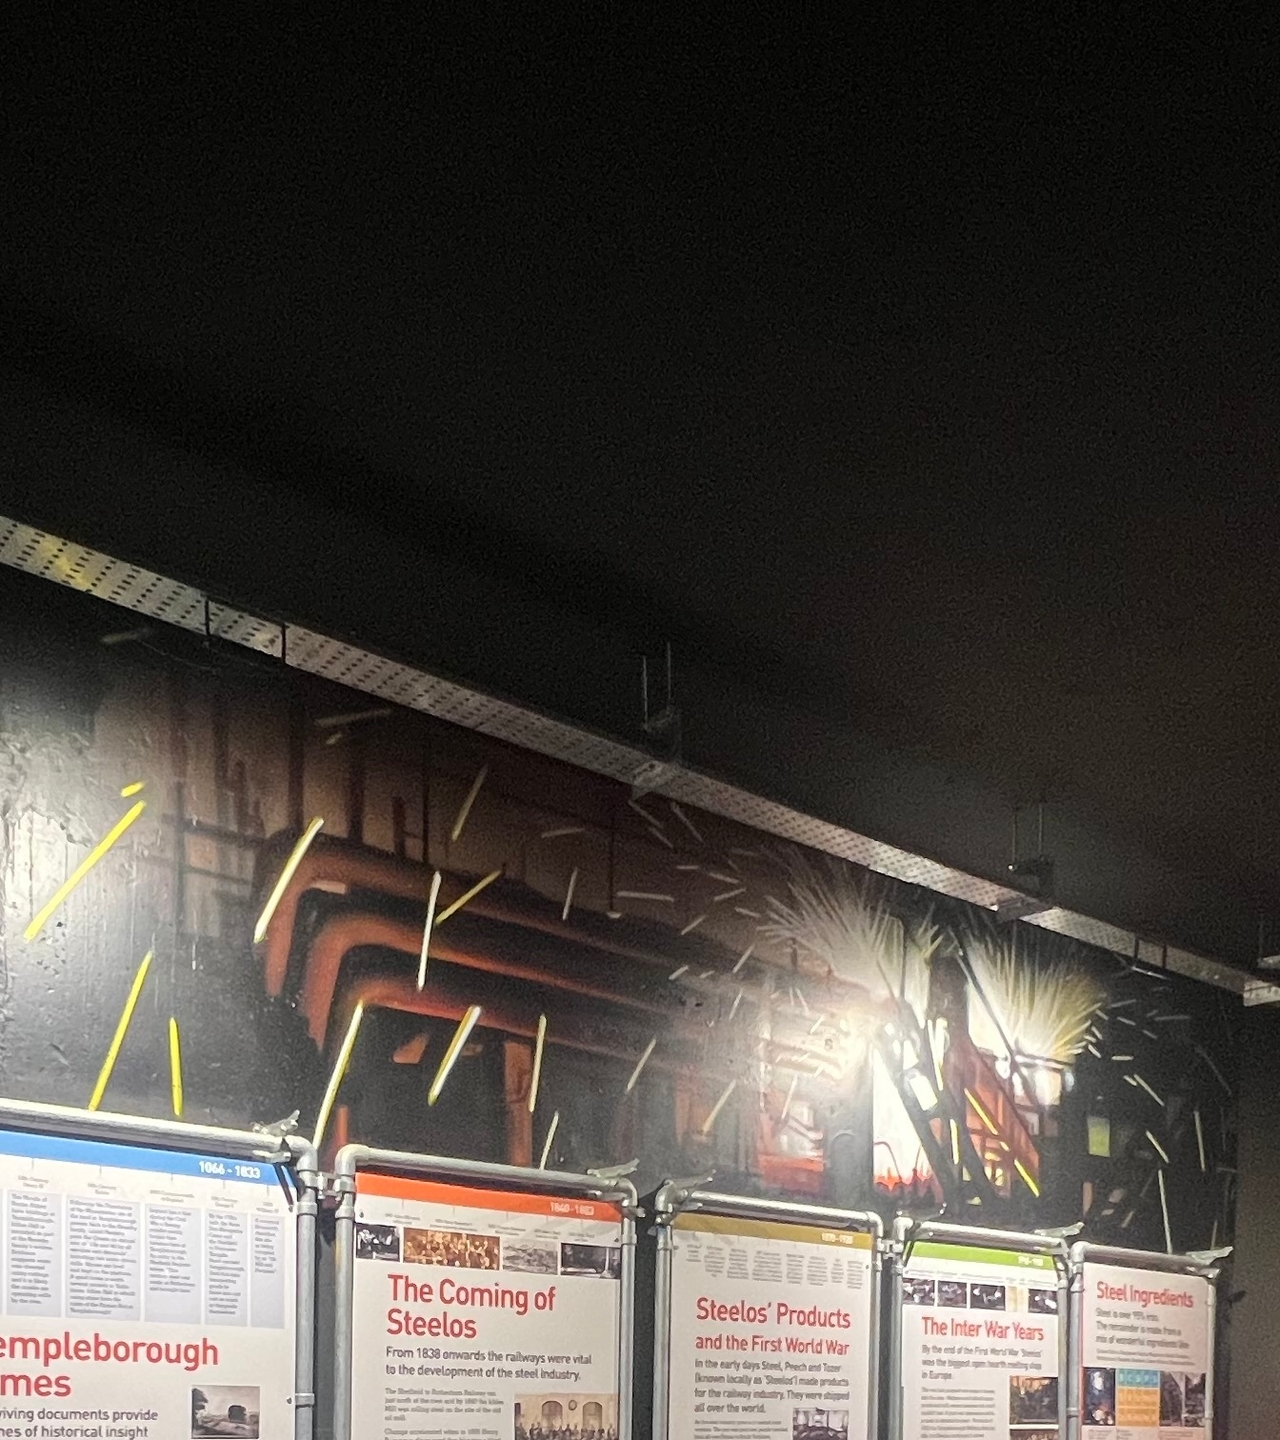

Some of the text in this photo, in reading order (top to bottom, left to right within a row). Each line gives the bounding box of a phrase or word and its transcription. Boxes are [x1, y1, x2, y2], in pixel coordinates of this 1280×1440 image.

[199, 1161, 225, 1175] 1066
[388, 1274, 556, 1315] The Coming of
[1097, 1281, 1194, 1308] Steel Ingredients
[387, 1308, 476, 1338] Steelos
[777, 1303, 850, 1328] Products
[922, 1316, 1044, 1341] The Inter War Years
[386, 1346, 414, 1358] From
[443, 1350, 486, 1361] onwards
[488, 1350, 503, 1361] the
[506, 1351, 545, 1364] railways
[548, 1356, 571, 1364] were
[573, 1355, 592, 1364] vital
[696, 1334, 849, 1355] and the First World War
[386, 1365, 396, 1375] to
[399, 1365, 415, 1375] the
[418, 1365, 483, 1379] development
[486, 1368, 495, 1377] of
[497, 1368, 513, 1378] the
[515, 1368, 539, 1379] steel
[37, 1408, 110, 1420] documents
[113, 1409, 158, 1423] provide
[25, 1426, 38, 1437] of
[41, 1426, 103, 1437] historical
[106, 1426, 148, 1440] insight
